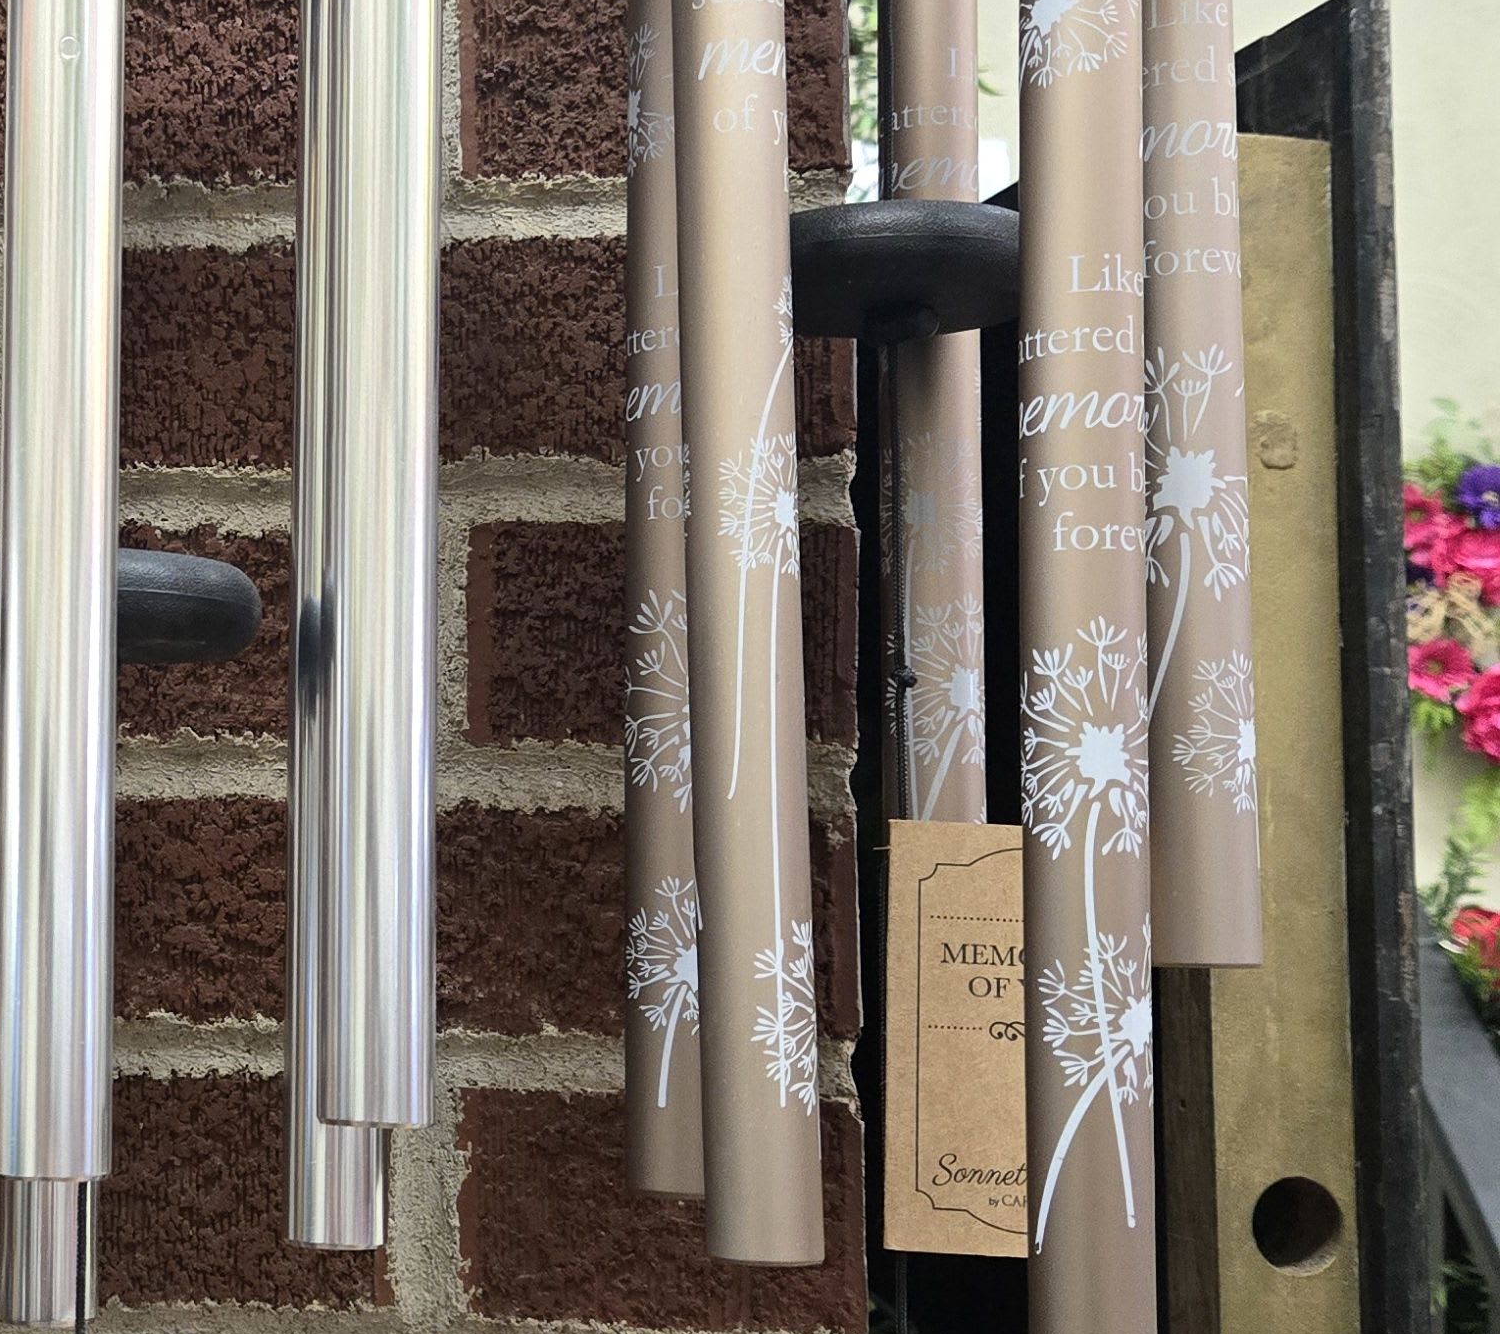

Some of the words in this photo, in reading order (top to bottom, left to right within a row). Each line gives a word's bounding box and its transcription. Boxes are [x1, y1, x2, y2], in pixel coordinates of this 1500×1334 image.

[713, 93, 758, 133] of
[1067, 253, 1143, 296] Like
[1037, 464, 1117, 507] you
[968, 975, 1011, 998] OF
[932, 1153, 1028, 1187] Sonnet
[988, 1197, 1000, 1208] by
